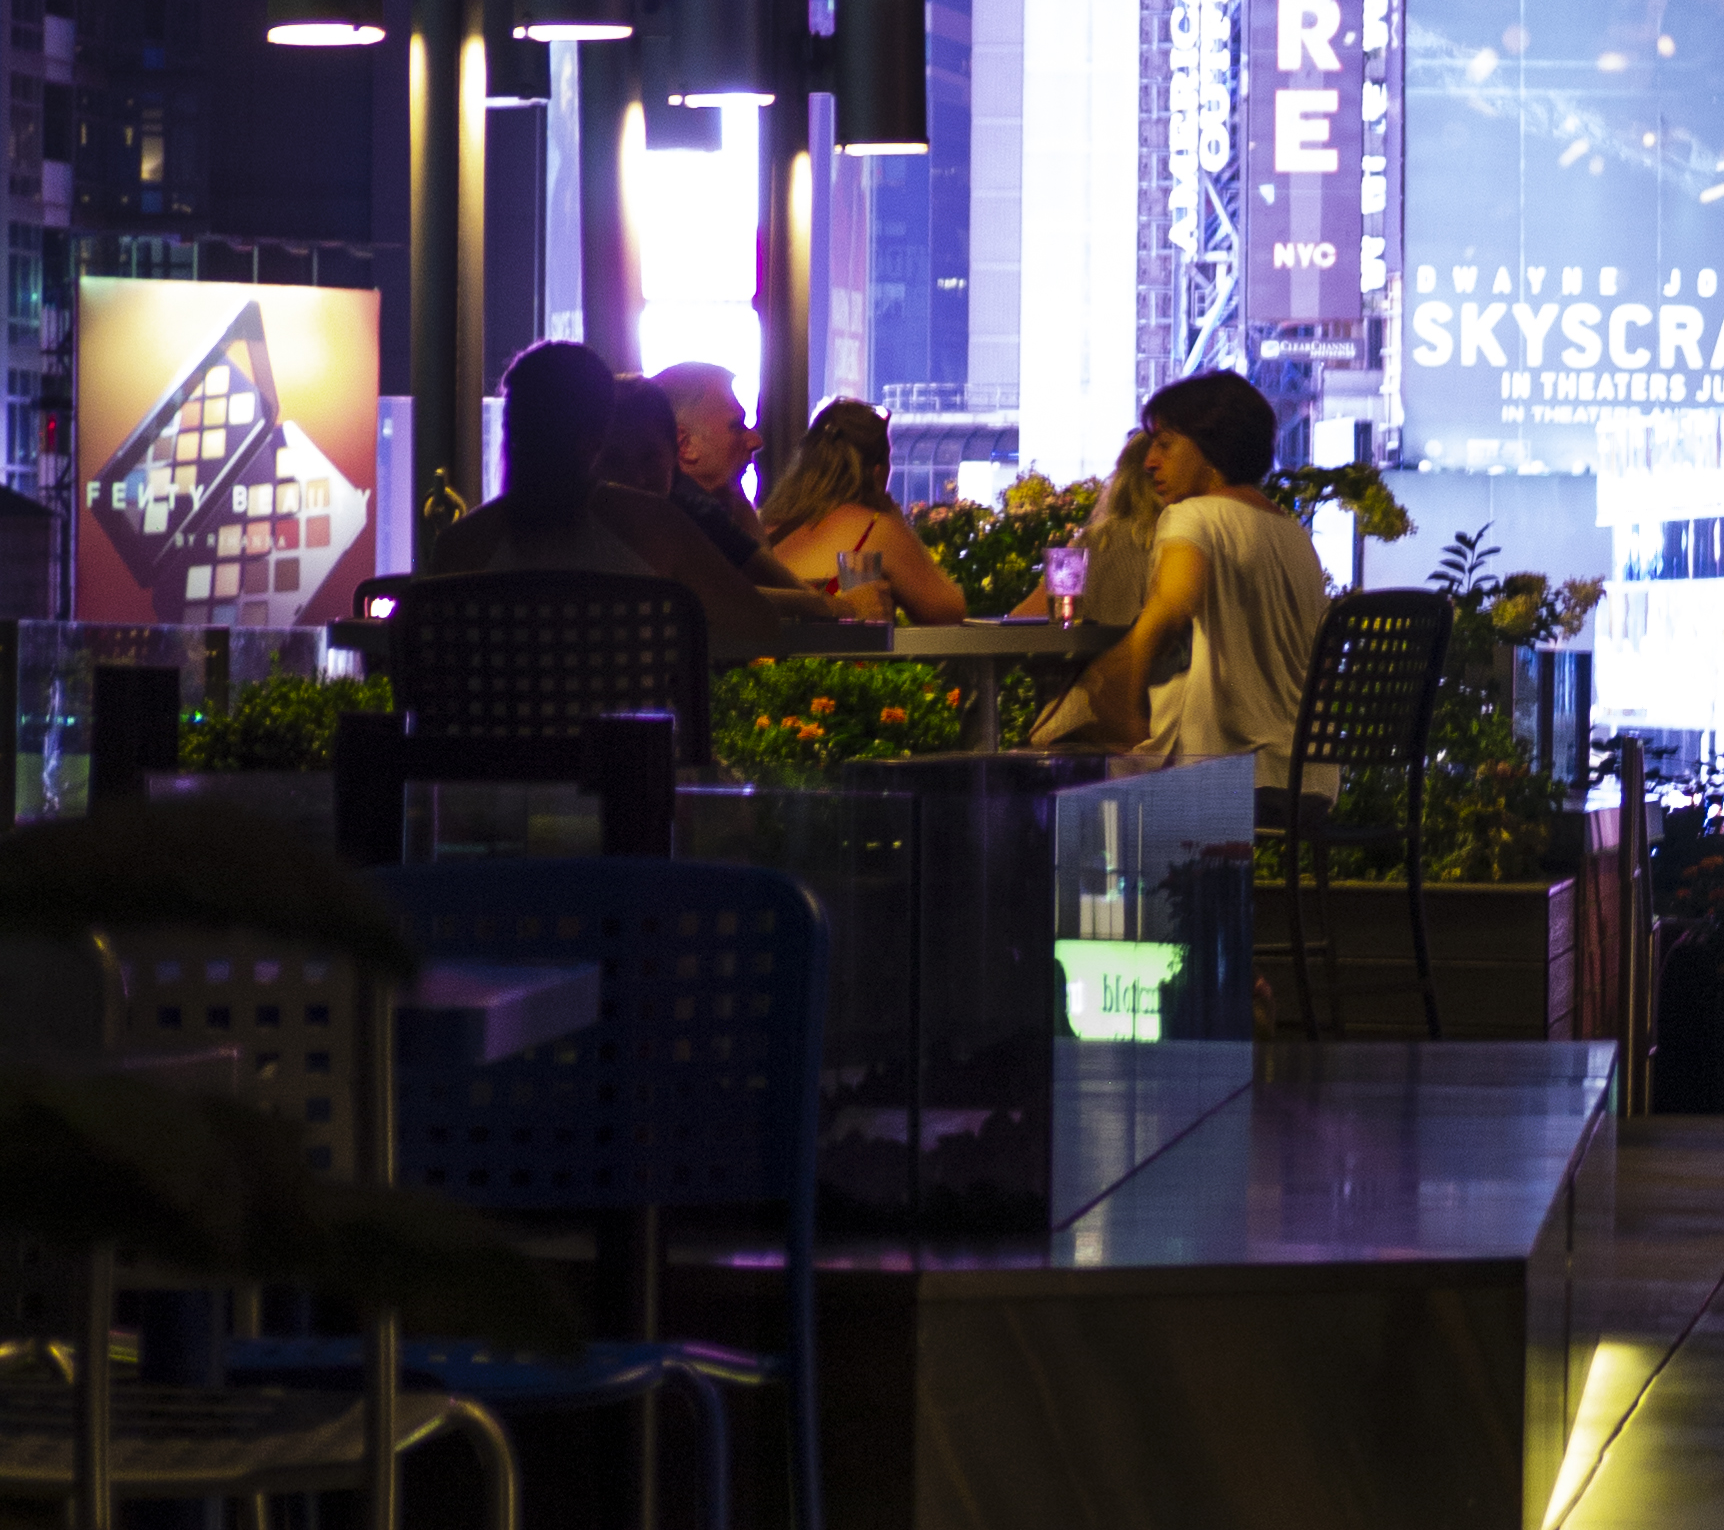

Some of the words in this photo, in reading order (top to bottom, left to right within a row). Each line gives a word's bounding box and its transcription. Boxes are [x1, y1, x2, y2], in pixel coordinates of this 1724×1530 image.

[1273, 242, 1337, 269] NYC
[1416, 264, 1618, 296] DWAYNE
[1501, 371, 1531, 400] IN
[1540, 371, 1686, 402] THEATERS
[1501, 405, 1525, 424] IN
[86, 480, 206, 510] FENTY
